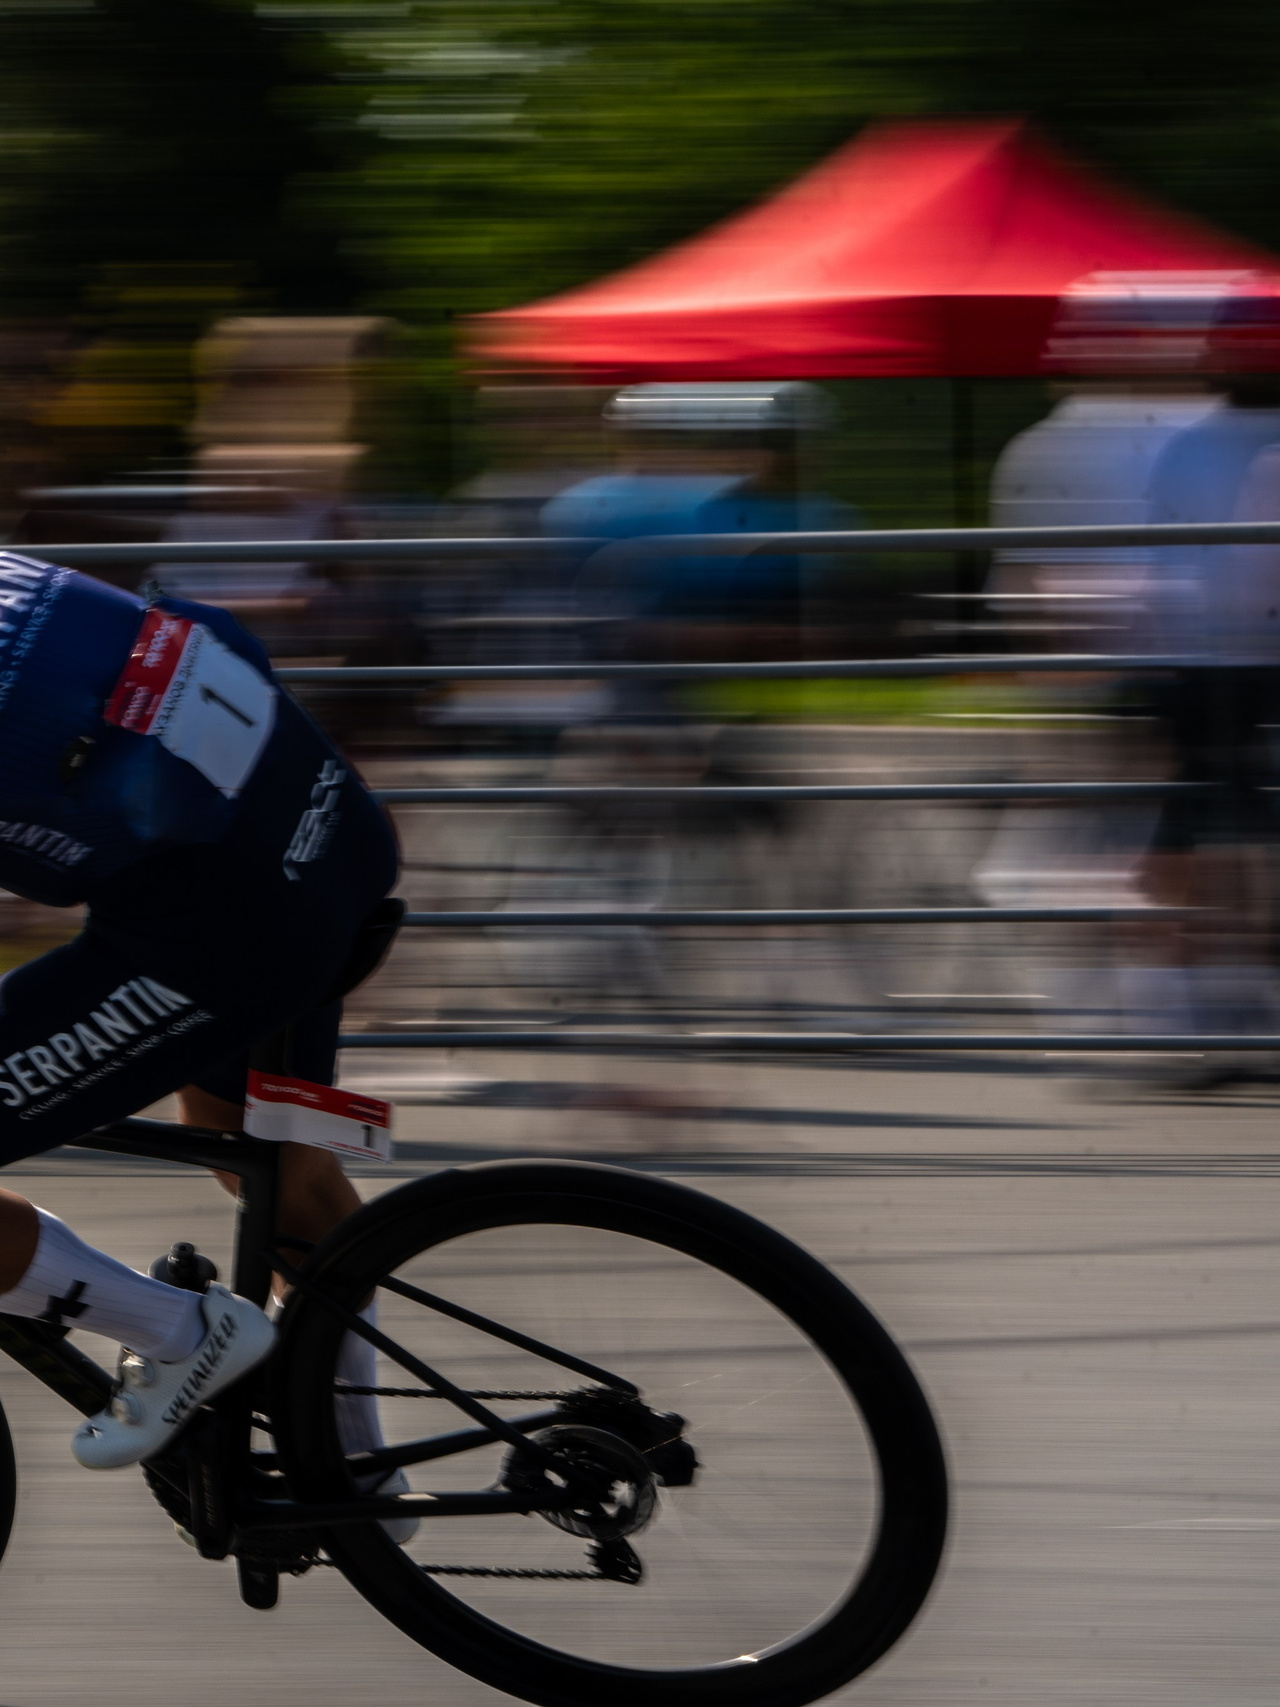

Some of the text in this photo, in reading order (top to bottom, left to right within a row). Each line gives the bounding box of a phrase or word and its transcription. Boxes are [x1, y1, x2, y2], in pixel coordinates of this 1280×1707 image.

[13, 600, 55, 659] SERVICE
[200, 682, 256, 729] 1
[18, 1008, 219, 1121] CYCLING SERVICE SHOP COFFEE
[361, 1124, 375, 1148] 1
[161, 1312, 238, 1425] SPECIALIZED
